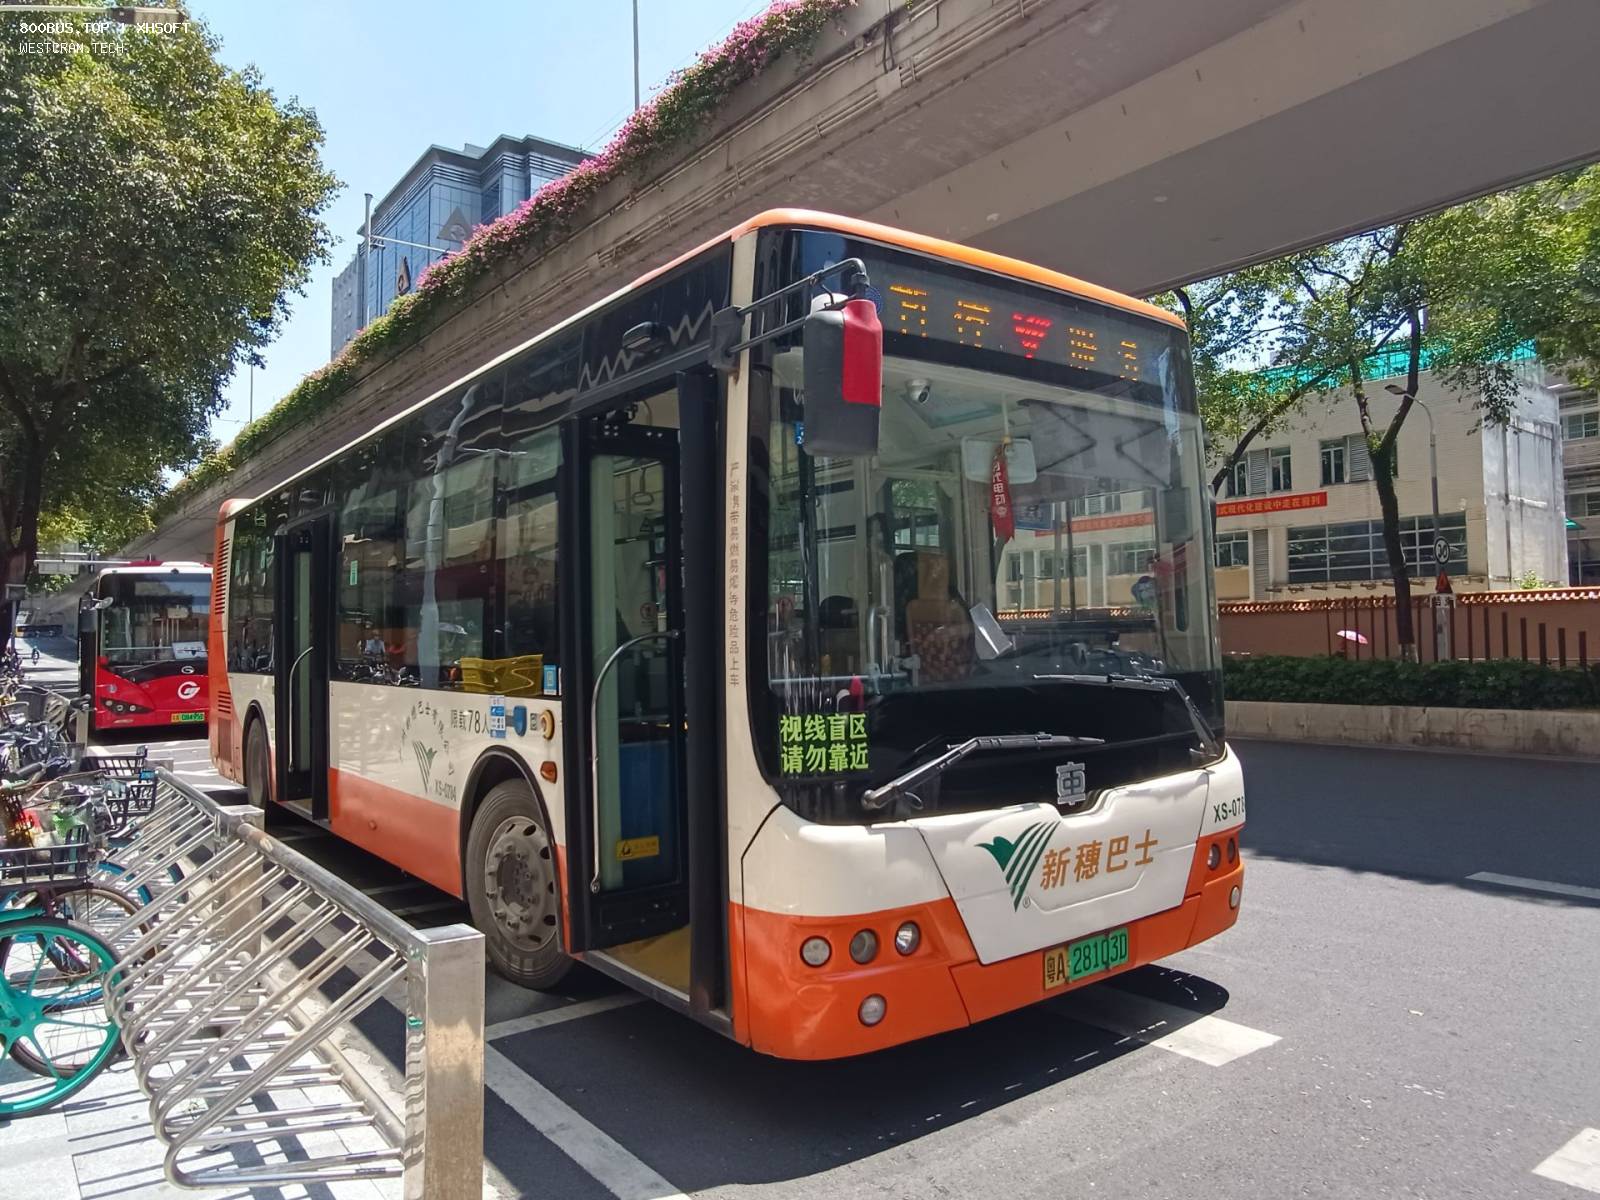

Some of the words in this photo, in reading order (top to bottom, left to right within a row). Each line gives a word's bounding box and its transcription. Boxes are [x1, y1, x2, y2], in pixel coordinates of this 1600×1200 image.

[779, 713, 868, 743] 视线盲区
[780, 742, 869, 774] 请勿靠近
[1039, 828, 1159, 890] 新穗巴士
